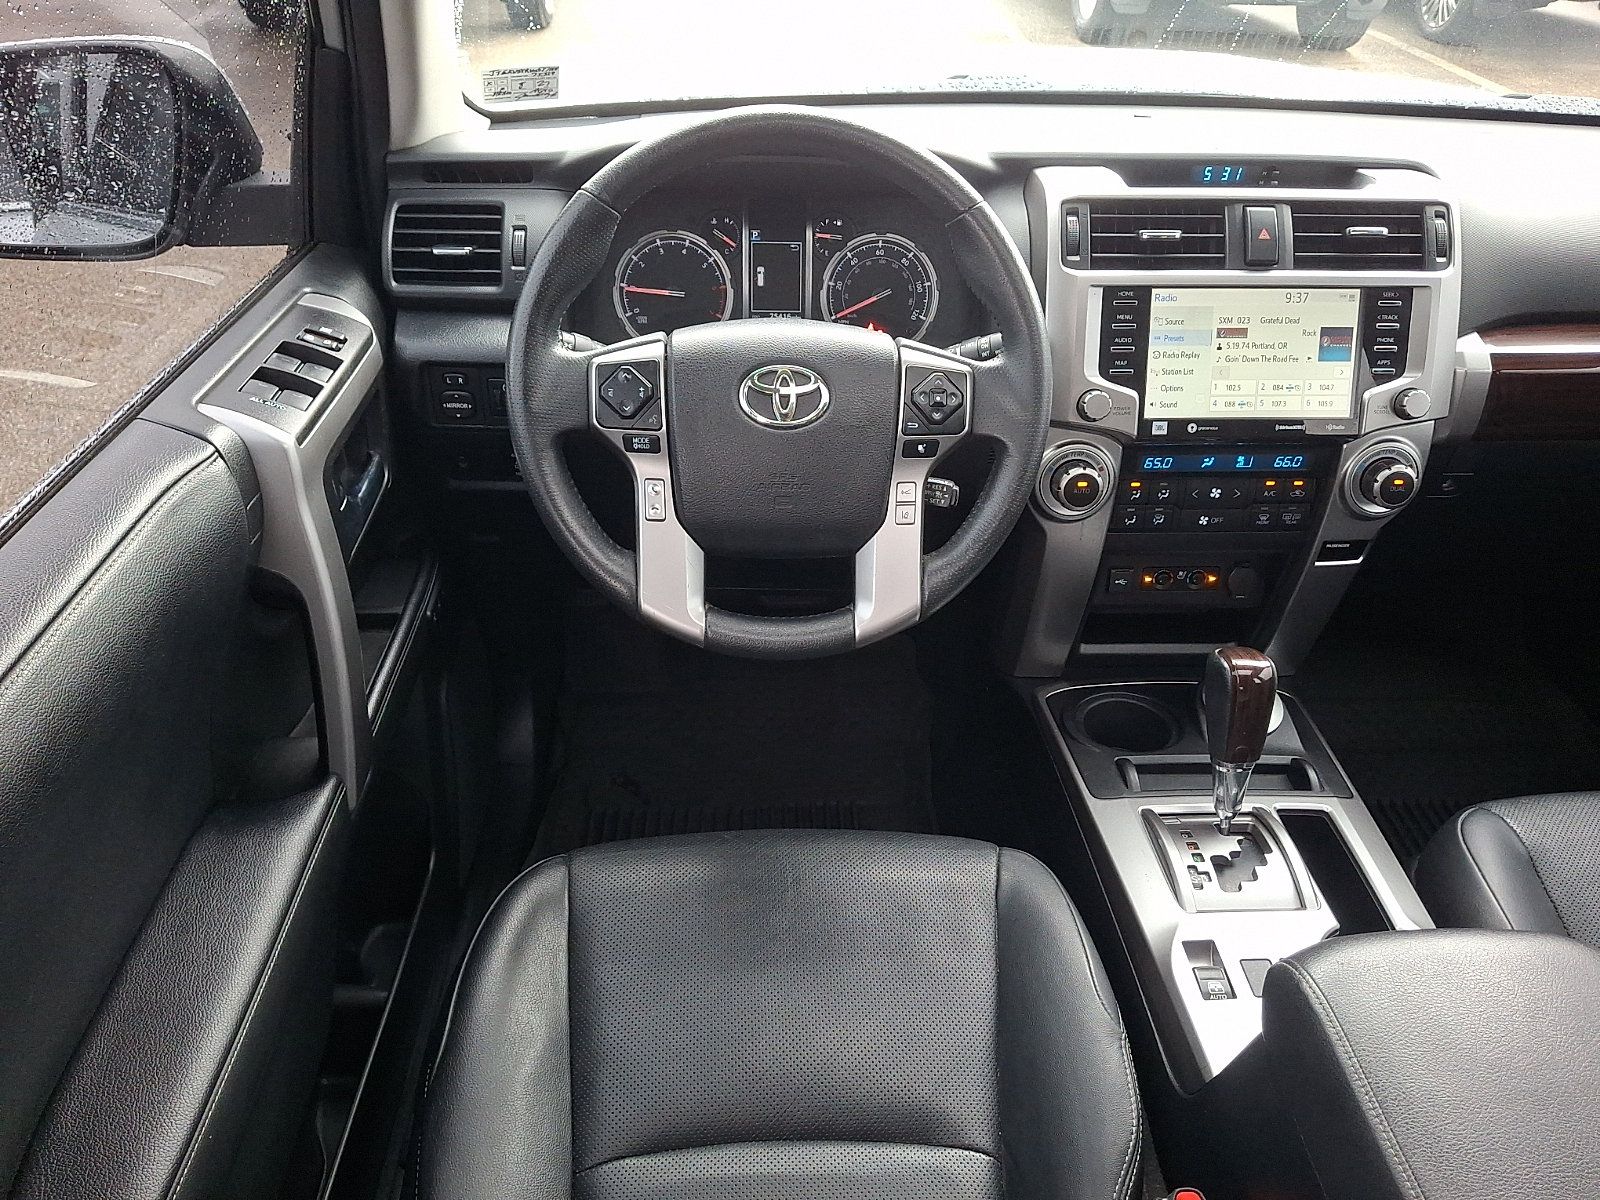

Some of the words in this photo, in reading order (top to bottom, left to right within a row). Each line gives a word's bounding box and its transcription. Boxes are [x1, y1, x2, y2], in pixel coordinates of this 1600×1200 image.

[752, 231, 758, 240] P
[850, 257, 859, 266] 40
[900, 257, 910, 267] 80
[836, 280, 843, 291] 20
[915, 280, 923, 293] 100
[1154, 293, 1178, 303] Radio
[1285, 291, 1310, 304] 9:37
[910, 309, 920, 321] 120
[1164, 317, 1185, 326] Source
[1218, 316, 1233, 325] SXM
[1236, 316, 1251, 324] 023
[1260, 316, 1284, 325] Grateful
[1284, 316, 1301, 325] Dead
[1301, 329, 1318, 337] Rock
[1163, 334, 1185, 343] Presets
[1277, 341, 1288, 350] OR
[1162, 351, 1180, 359] Radio
[1180, 351, 1201, 361] Replay
[1241, 354, 1260, 363] Down
[1260, 354, 1272, 363] The
[1272, 354, 1288, 363] Road
[1161, 368, 1182, 376] Station
[1182, 368, 1194, 376] List
[1160, 384, 1184, 393] Options
[1260, 383, 1266, 391] 2
[1307, 383, 1312, 391] 3
[249, 396, 264, 404] ALL
[264, 400, 287, 410] AUTO
[1159, 400, 1178, 408] Sound
[632, 436, 651, 444] MODE
[1143, 457, 1173, 469] 65.0
[1273, 456, 1303, 468] 66.0
[1263, 490, 1276, 498] A/C
[1210, 516, 1224, 524] OFF
